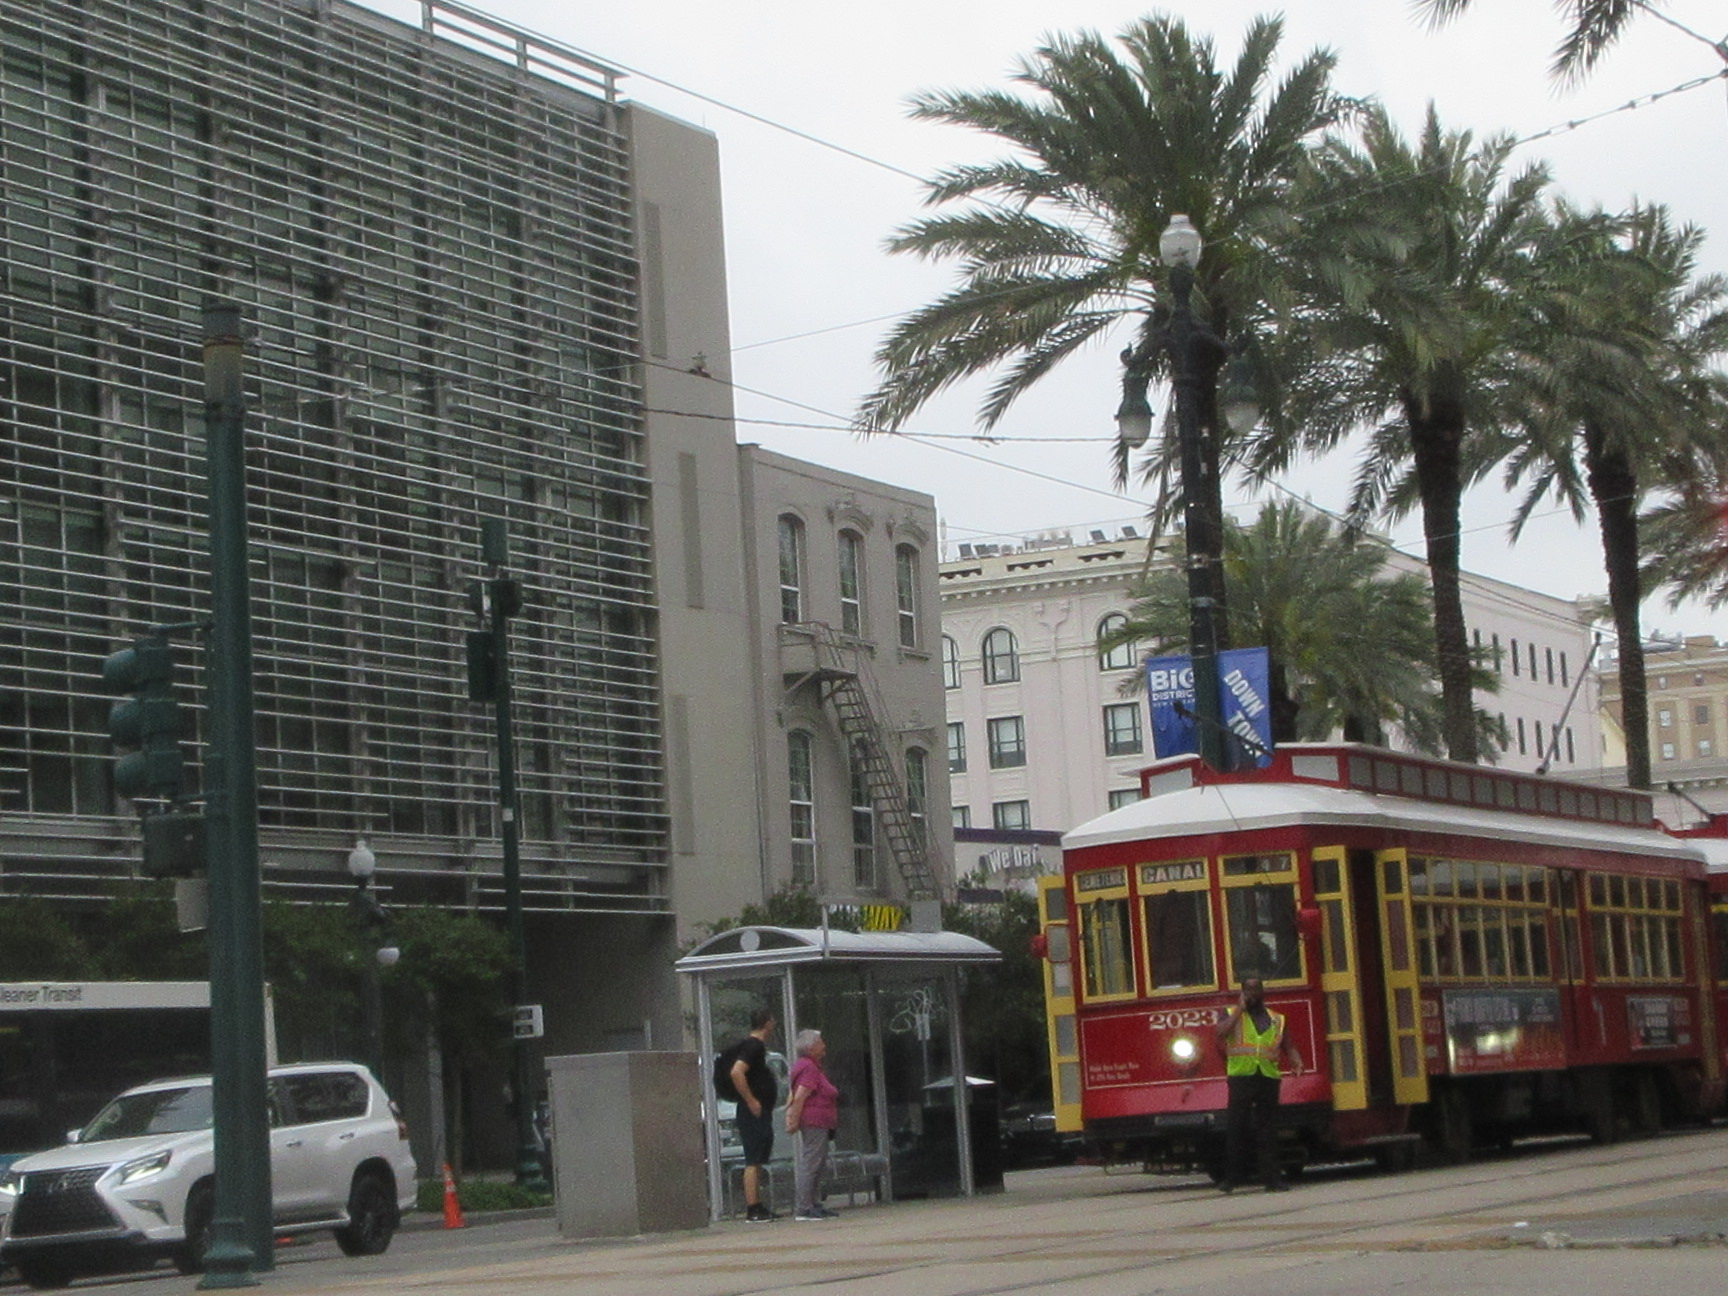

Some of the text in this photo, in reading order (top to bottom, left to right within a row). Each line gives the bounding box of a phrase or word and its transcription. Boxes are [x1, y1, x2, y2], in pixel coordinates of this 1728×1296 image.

[1152, 689, 1195, 702] DISTRIC
[1223, 669, 1265, 718] DOWN
[988, 847, 1011, 873] We
[1142, 860, 1203, 884] CANAL
[42, 985, 82, 1002] Transit
[1148, 1008, 1219, 1031] 2023
